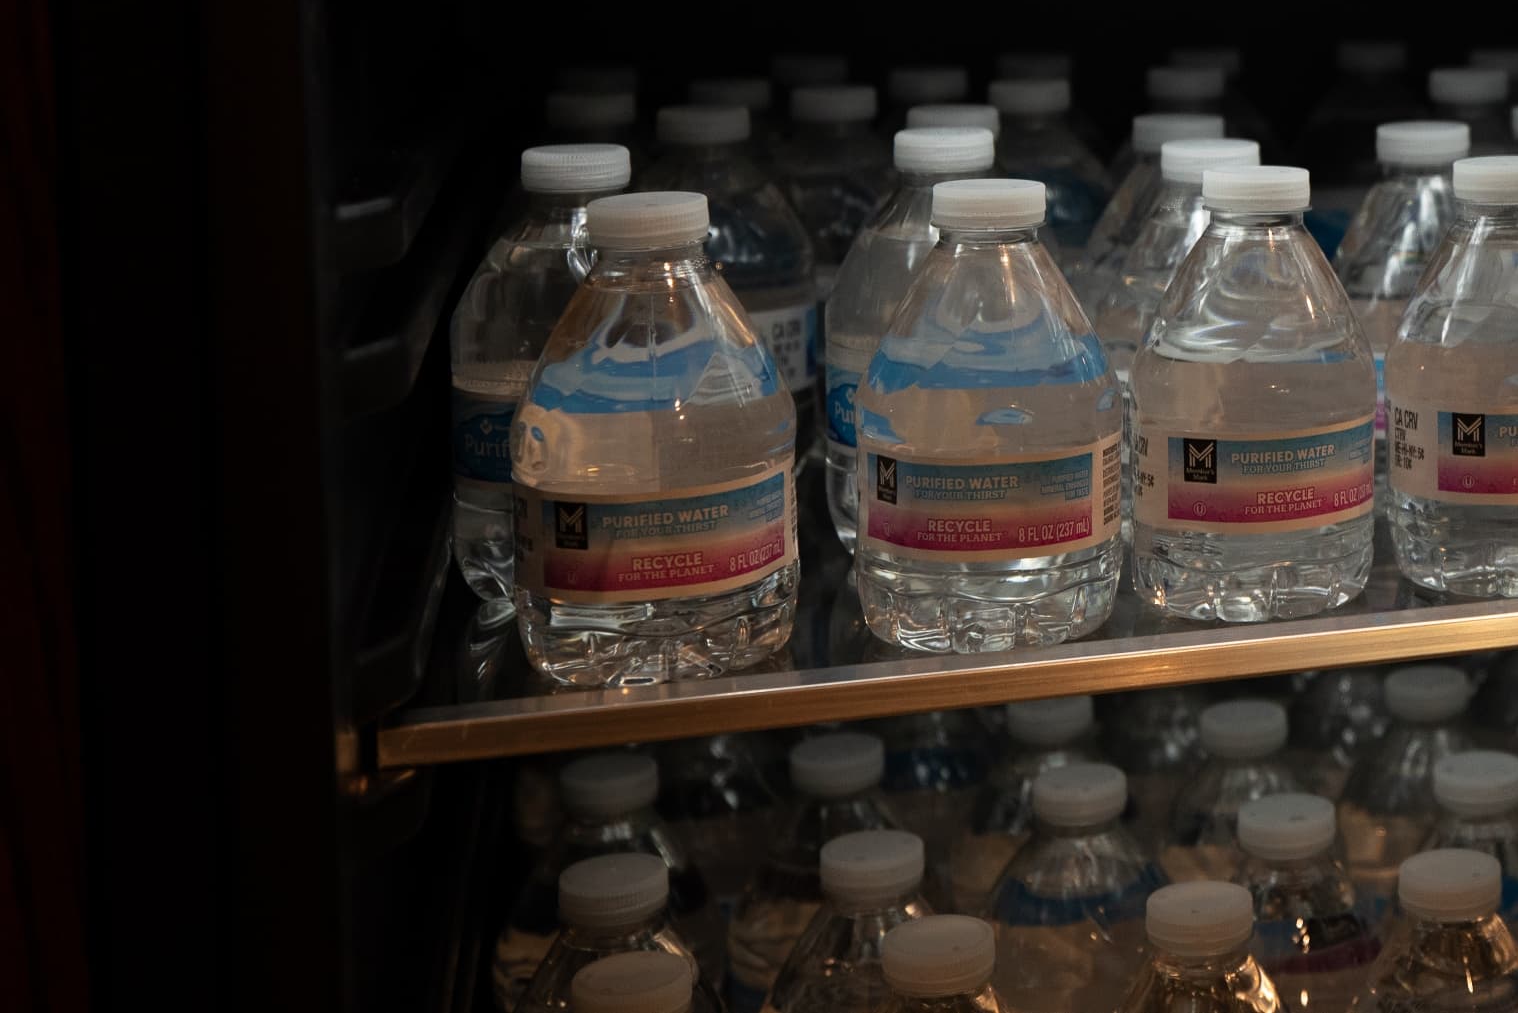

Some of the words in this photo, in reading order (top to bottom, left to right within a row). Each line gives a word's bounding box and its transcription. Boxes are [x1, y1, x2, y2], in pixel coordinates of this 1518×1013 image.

[1394, 407, 1403, 426] CA
[1404, 410, 1418, 430] CRV
[1231, 451, 1294, 464] PURIFIED
[1296, 444, 1336, 459] WATER
[1243, 463, 1265, 474] FOR
[1267, 462, 1293, 473] YOUR
[1294, 458, 1325, 470] THIRST
[905, 475, 965, 490] PURIFIED
[969, 475, 1019, 490] WATER
[966, 490, 1006, 500] THIRST
[1257, 488, 1315, 504] RECYCLE
[1334, 492, 1339, 507] 8
[1340, 490, 1348, 506] FL
[1349, 488, 1358, 503] OZ
[1244, 505, 1265, 515] FOR
[1267, 504, 1287, 514] THE
[1288, 499, 1323, 513] PLANET
[602, 512, 674, 529] PURIFIED
[678, 504, 729, 523] WATER
[928, 519, 991, 532] RECYCLE
[917, 532, 935, 541] FOR
[937, 533, 958, 542] THE
[960, 532, 1002, 542] PLANET
[1018, 527, 1025, 543] 8
[1028, 526, 1039, 542] FL
[1041, 525, 1054, 541] OZ
[1056, 521, 1074, 541] (237
[1075, 518, 1090, 536] mL)
[632, 552, 703, 571] RECYCLE
[729, 556, 737, 572] 8
[737, 554, 748, 569] FL
[749, 549, 760, 565] OZ
[759, 543, 773, 565] (237
[618, 572, 641, 582] FOR
[643, 570, 667, 580] THE
[669, 564, 714, 579] PLANET
